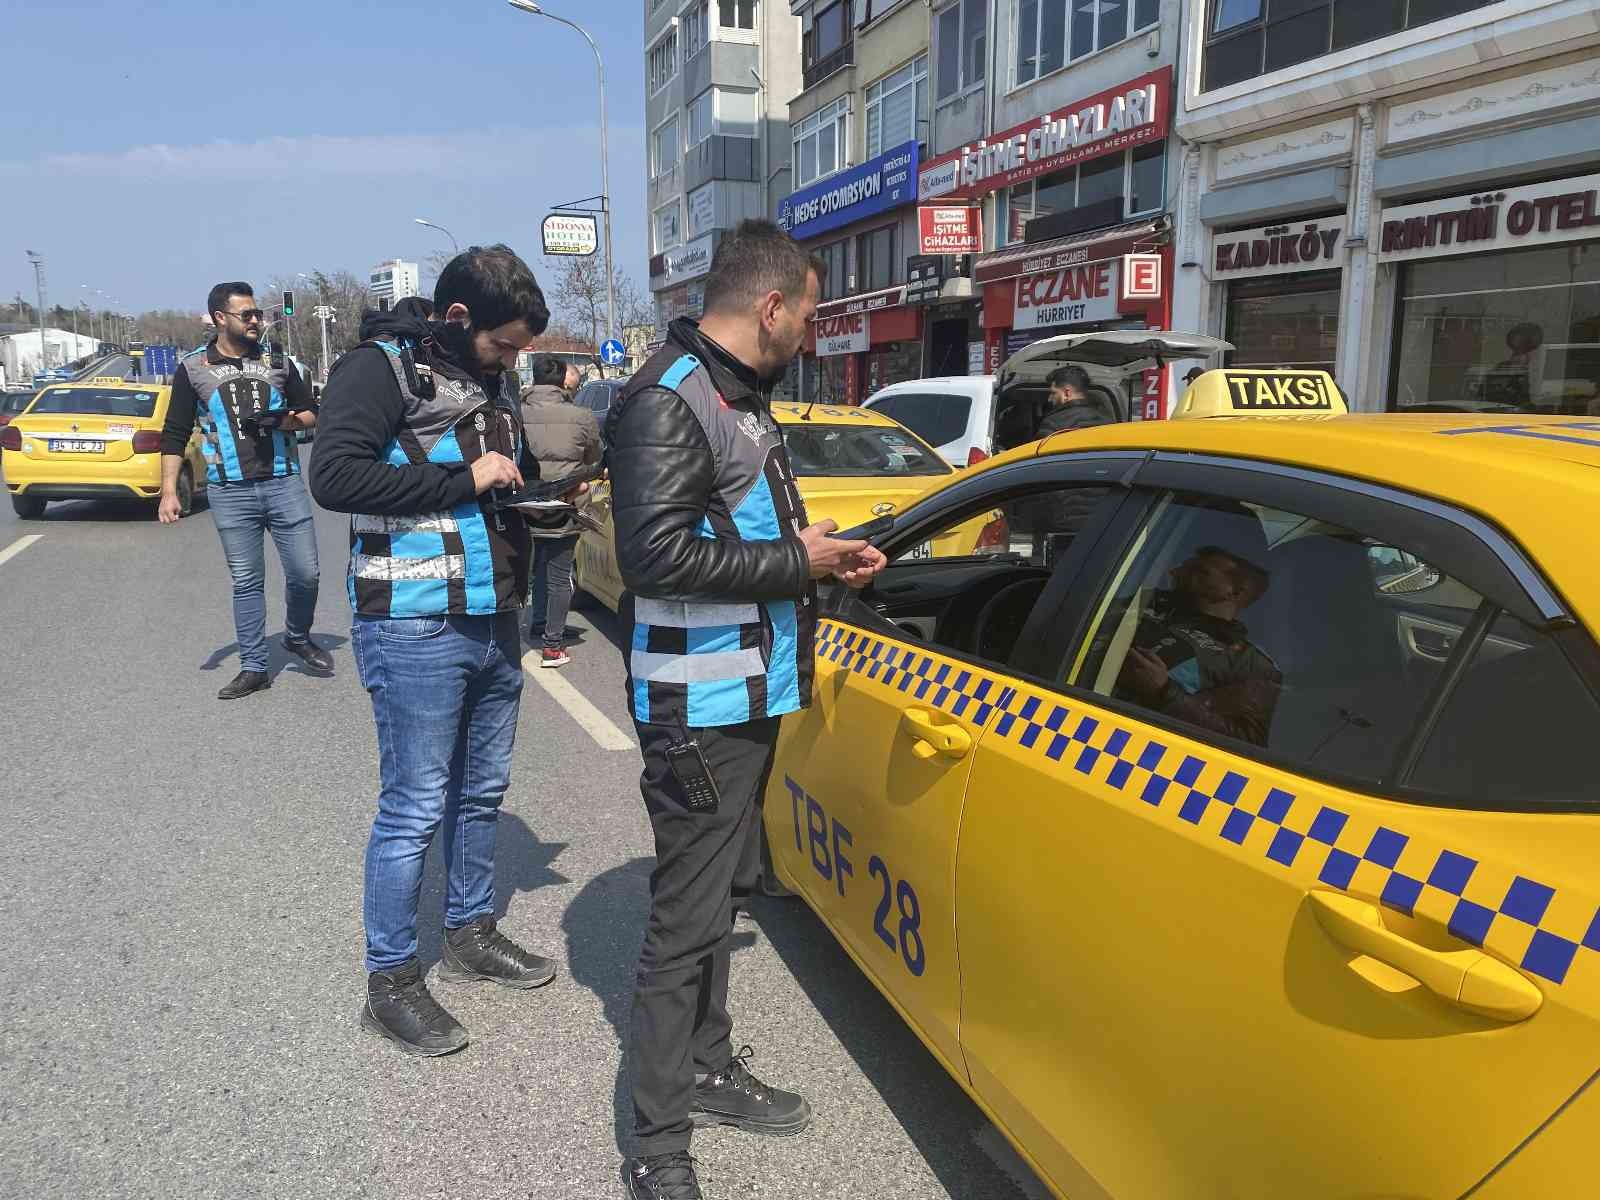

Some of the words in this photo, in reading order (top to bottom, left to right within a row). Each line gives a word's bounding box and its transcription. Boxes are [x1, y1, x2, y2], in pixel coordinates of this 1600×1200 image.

[1026, 83, 1157, 162] CİHAZLARI
[1046, 145, 1101, 168] UYGULAMA
[794, 197, 819, 225] HEDEF
[820, 171, 881, 215] OTOMASYON
[1506, 189, 1600, 237] OTEL
[545, 231, 594, 241] HOTEL
[924, 235, 978, 247] CİHAZLARI
[1017, 263, 1110, 309] ECZANE
[1134, 264, 1154, 290] E
[784, 774, 854, 897] TBF
[868, 855, 925, 977] 28
